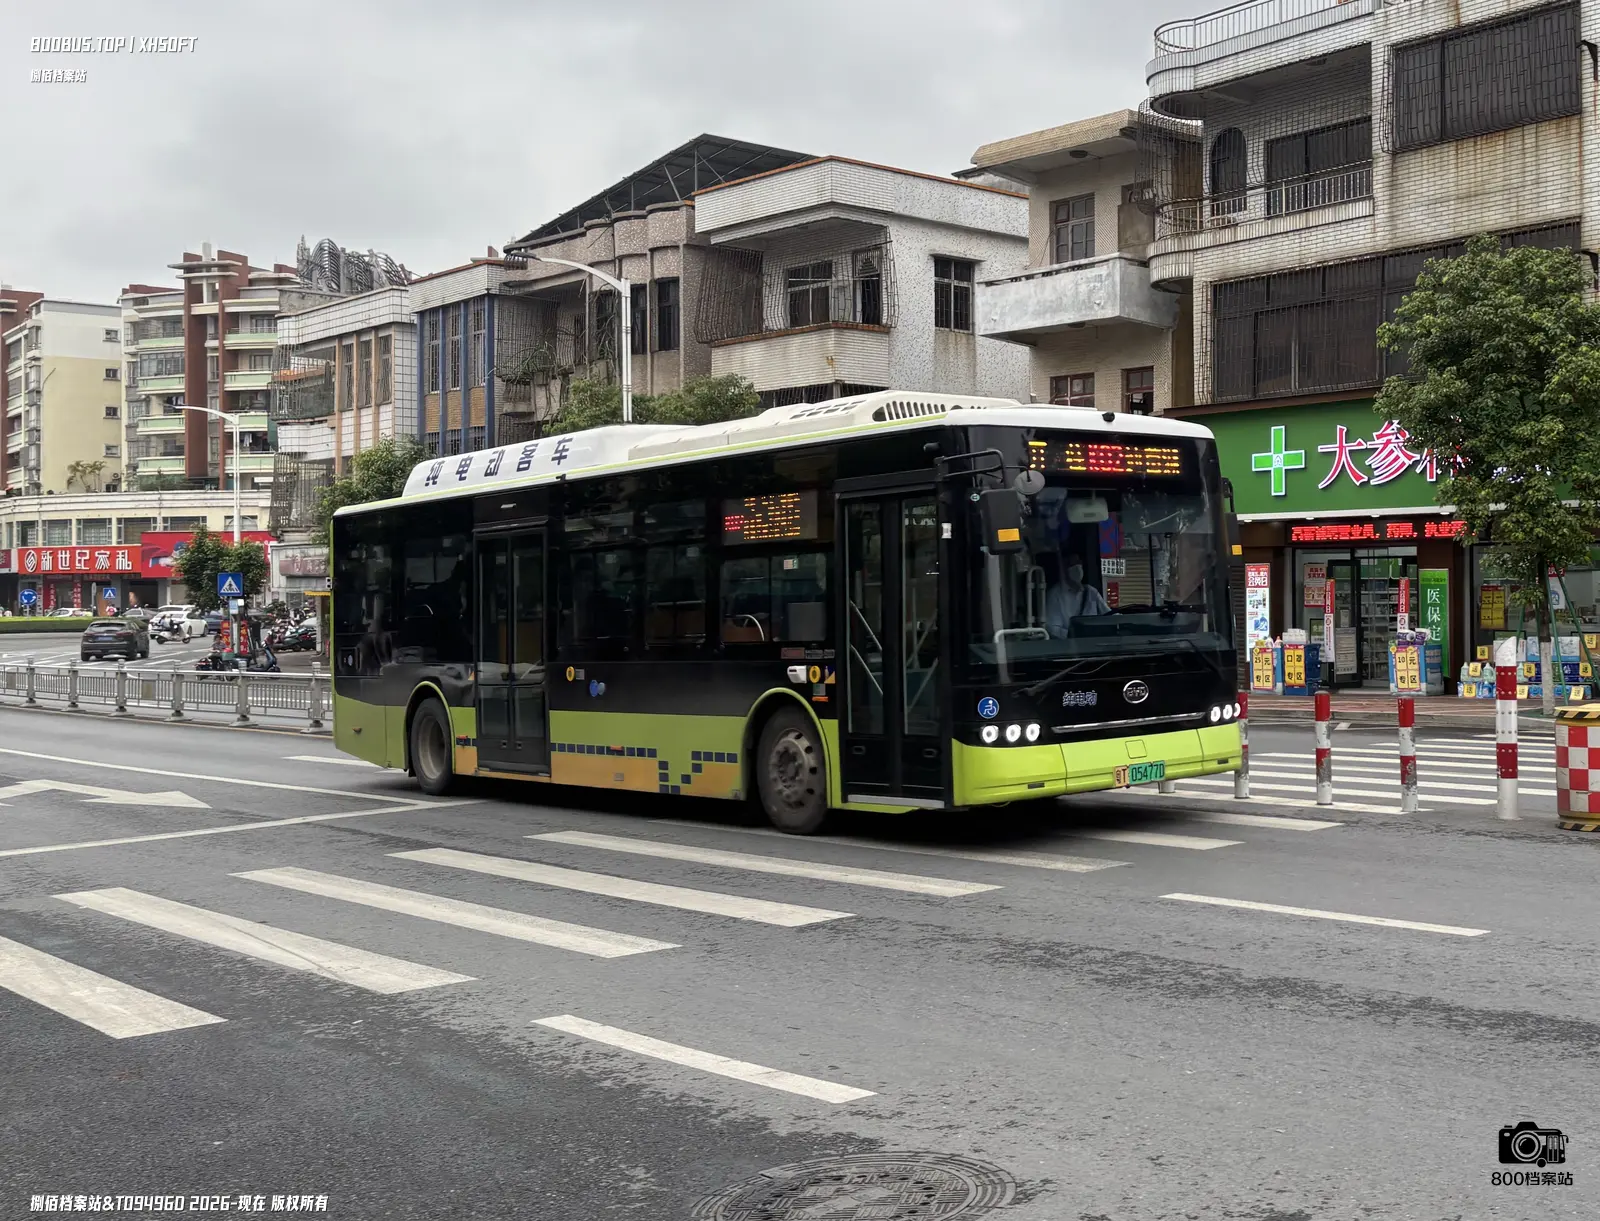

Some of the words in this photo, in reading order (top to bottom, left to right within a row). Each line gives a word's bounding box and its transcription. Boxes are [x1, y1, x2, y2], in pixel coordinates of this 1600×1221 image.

[424, 437, 573, 487] 纯电动客车
[40, 549, 133, 571] 新世纪家私
[1062, 689, 1098, 707] 纯电动
